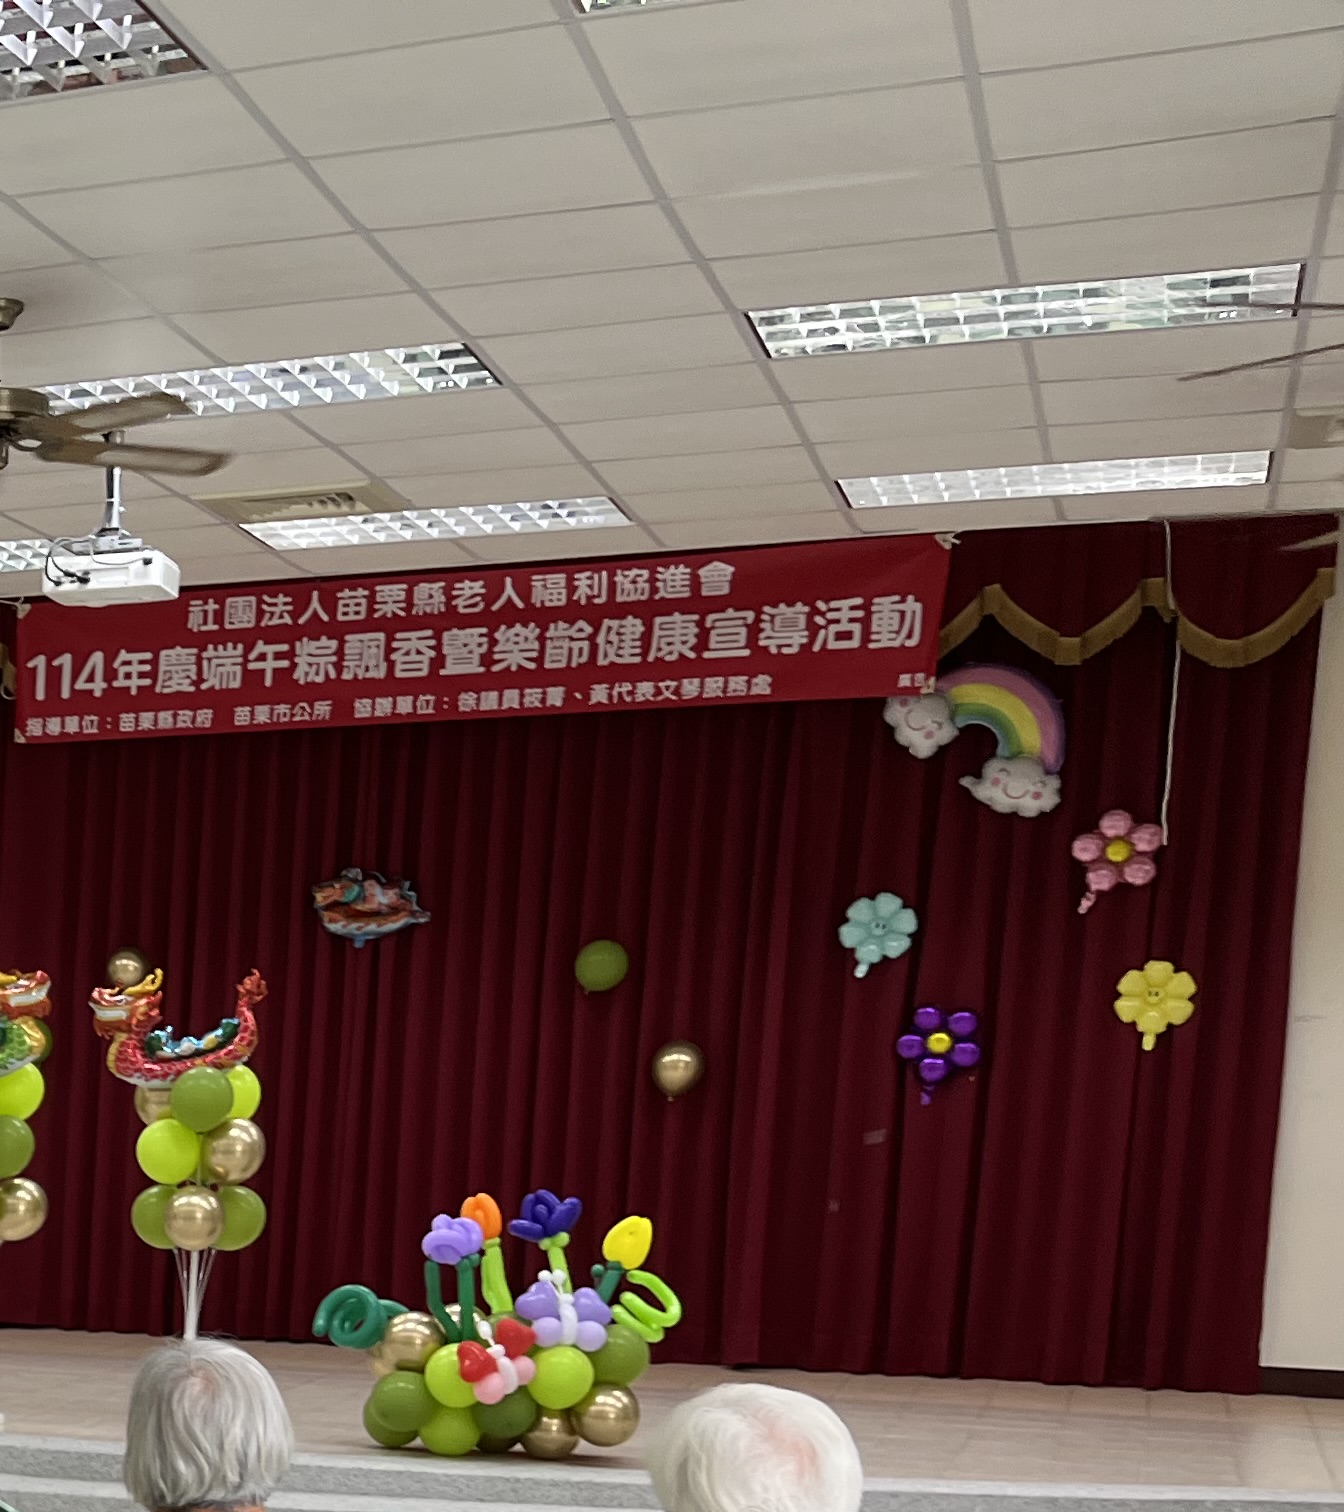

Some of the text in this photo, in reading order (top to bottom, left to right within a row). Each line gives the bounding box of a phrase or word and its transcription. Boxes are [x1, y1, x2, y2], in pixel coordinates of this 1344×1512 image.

[187, 560, 735, 632] 社團法人苗栗縣老人福利協進會
[25, 594, 924, 702] 114年慶端午粽飄香暨樂齡健康宣導活動
